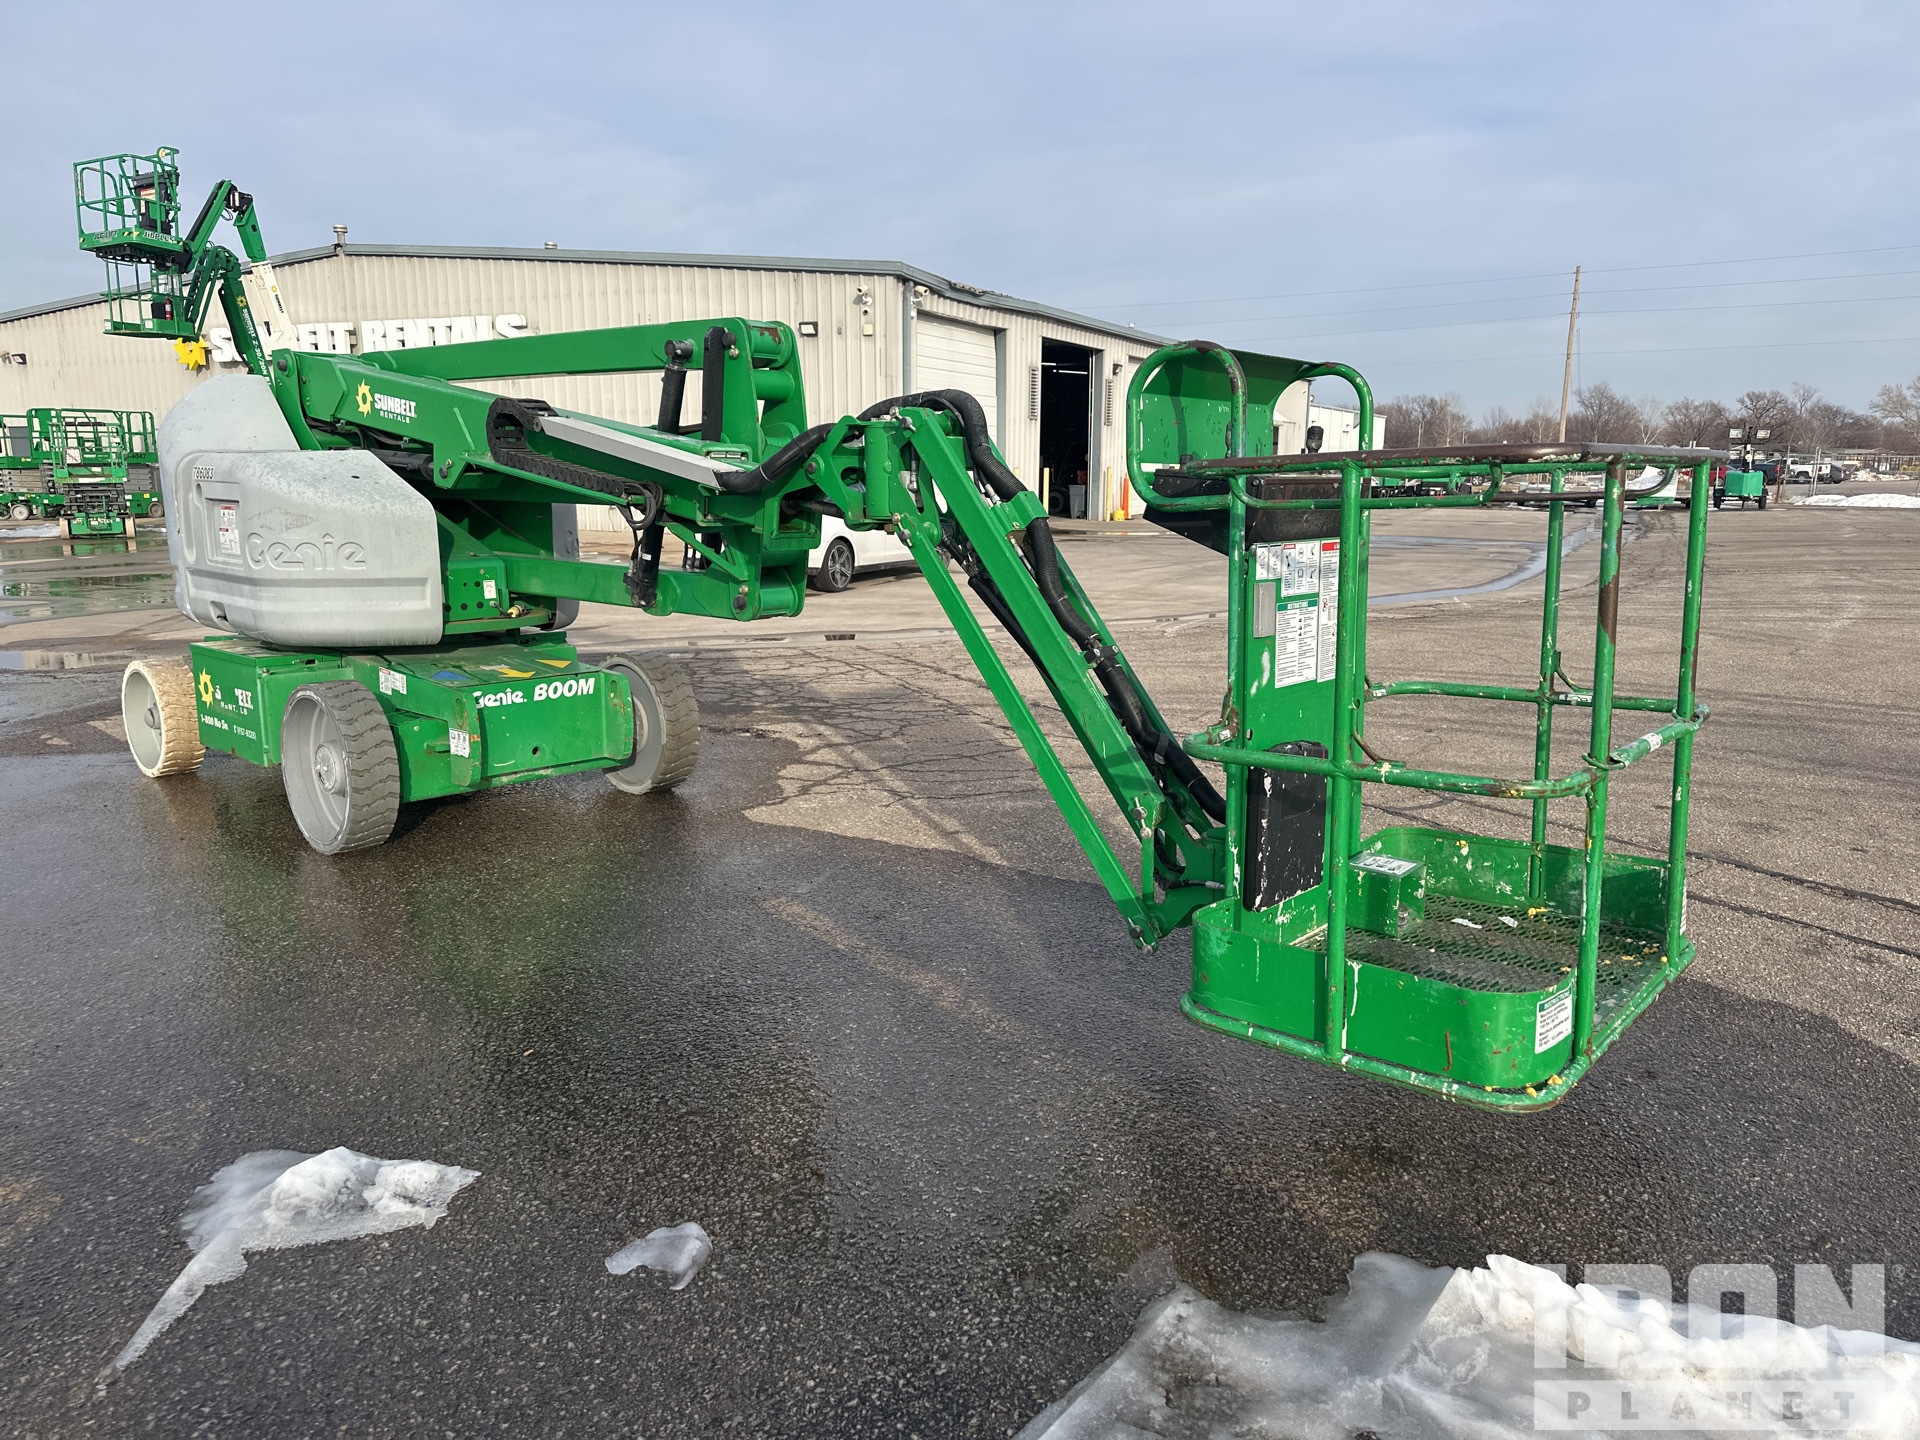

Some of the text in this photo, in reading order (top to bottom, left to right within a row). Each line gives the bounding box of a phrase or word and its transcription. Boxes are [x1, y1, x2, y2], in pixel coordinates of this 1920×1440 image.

[374, 392, 417, 418] SUNBELT
[380, 410, 410, 424] RENTALS
[533, 677, 596, 702] BOOM
